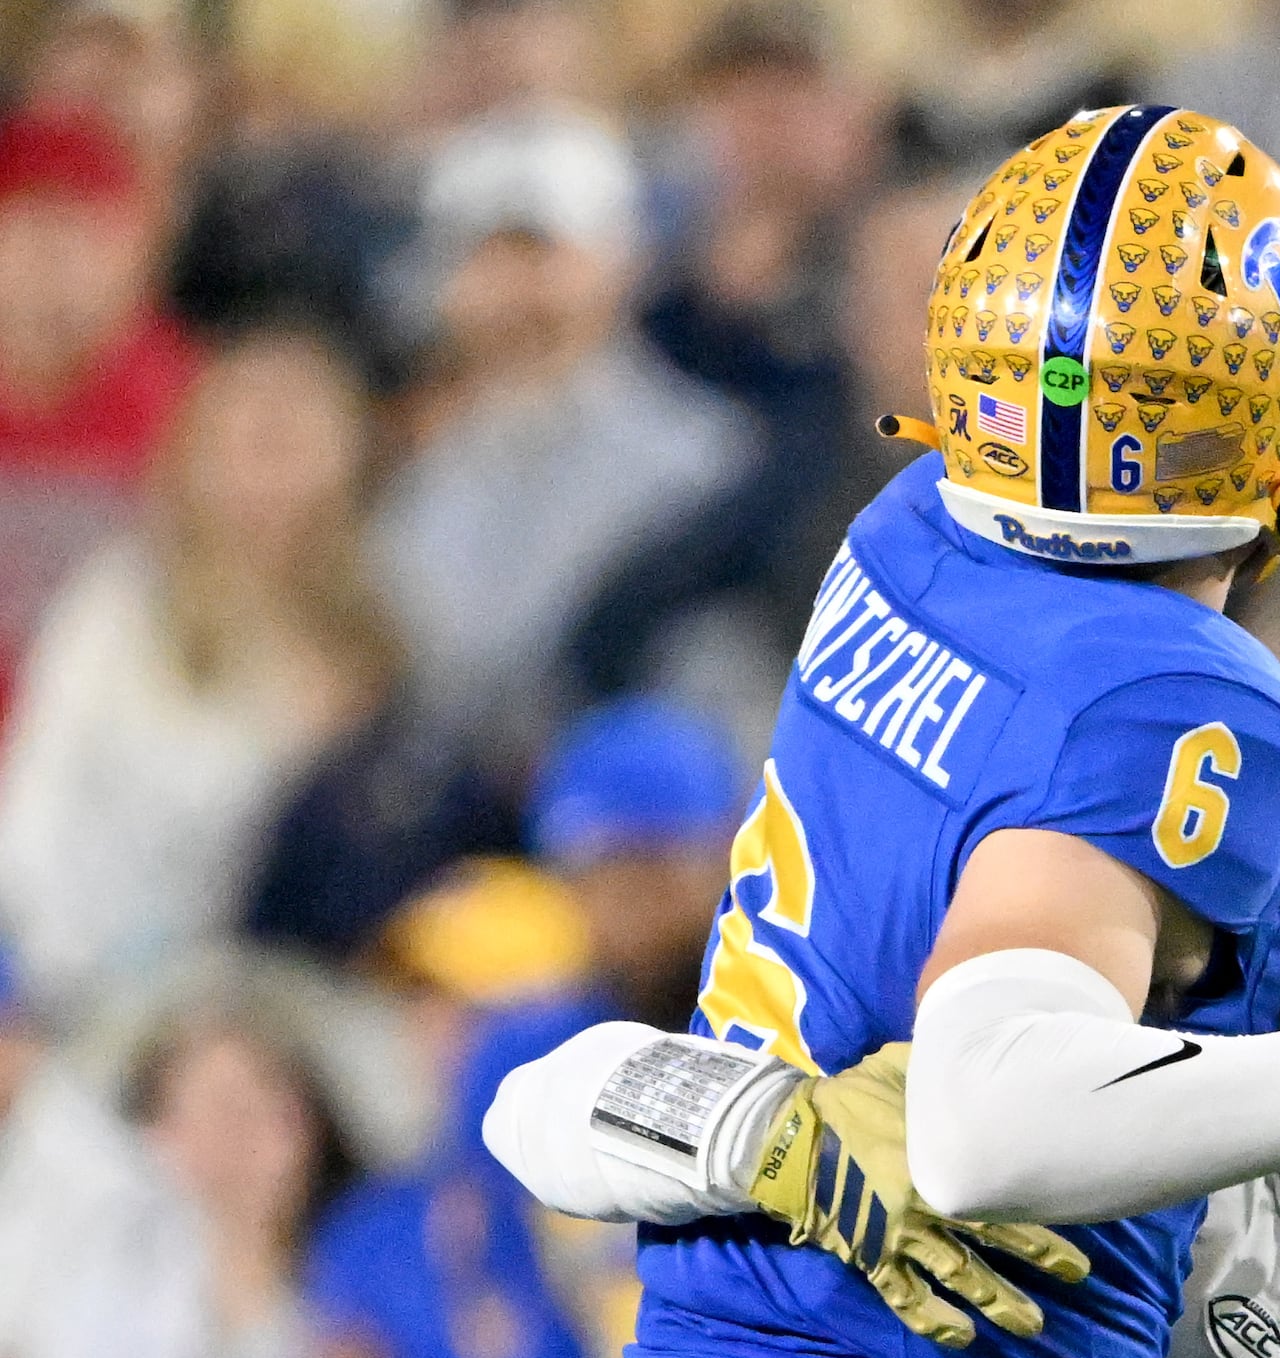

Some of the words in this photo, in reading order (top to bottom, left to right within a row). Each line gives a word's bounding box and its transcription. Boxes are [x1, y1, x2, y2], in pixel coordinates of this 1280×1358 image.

[1044, 370, 1084, 390] C2P
[984, 450, 1019, 468] ACC
[1110, 433, 1143, 494] 6
[993, 514, 1132, 559] Panthers
[1152, 721, 1242, 869] 6
[1219, 1311, 1280, 1358] ACC
